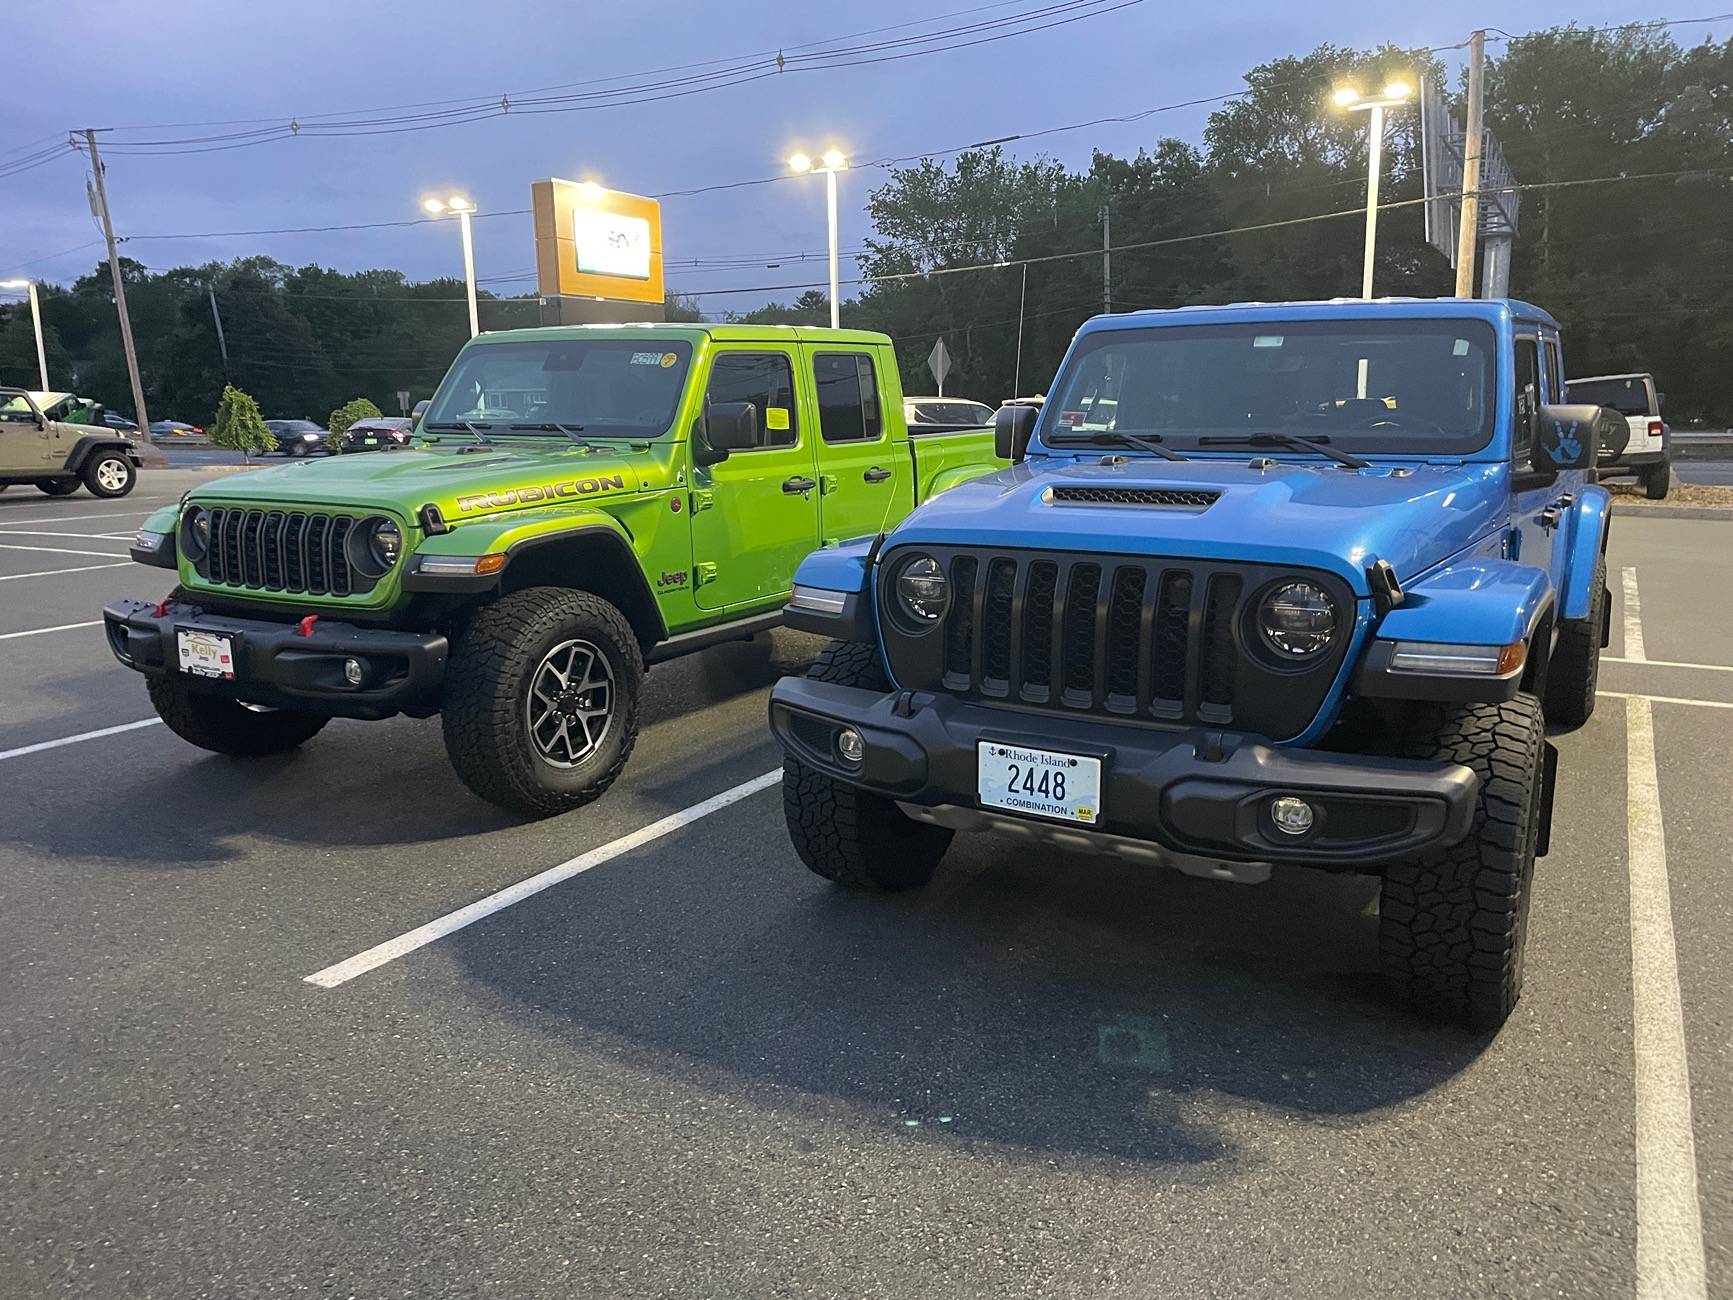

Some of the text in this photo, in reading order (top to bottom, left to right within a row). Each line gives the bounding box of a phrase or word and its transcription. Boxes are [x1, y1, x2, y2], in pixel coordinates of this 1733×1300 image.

[456, 475, 624, 512] RUBICON
[657, 571, 687, 587] Jeep
[191, 643, 217, 660] Kelly
[1004, 748, 1071, 769] Rhode Island
[1007, 764, 1066, 801] 2448
[1006, 797, 1068, 815] COMBINATION
